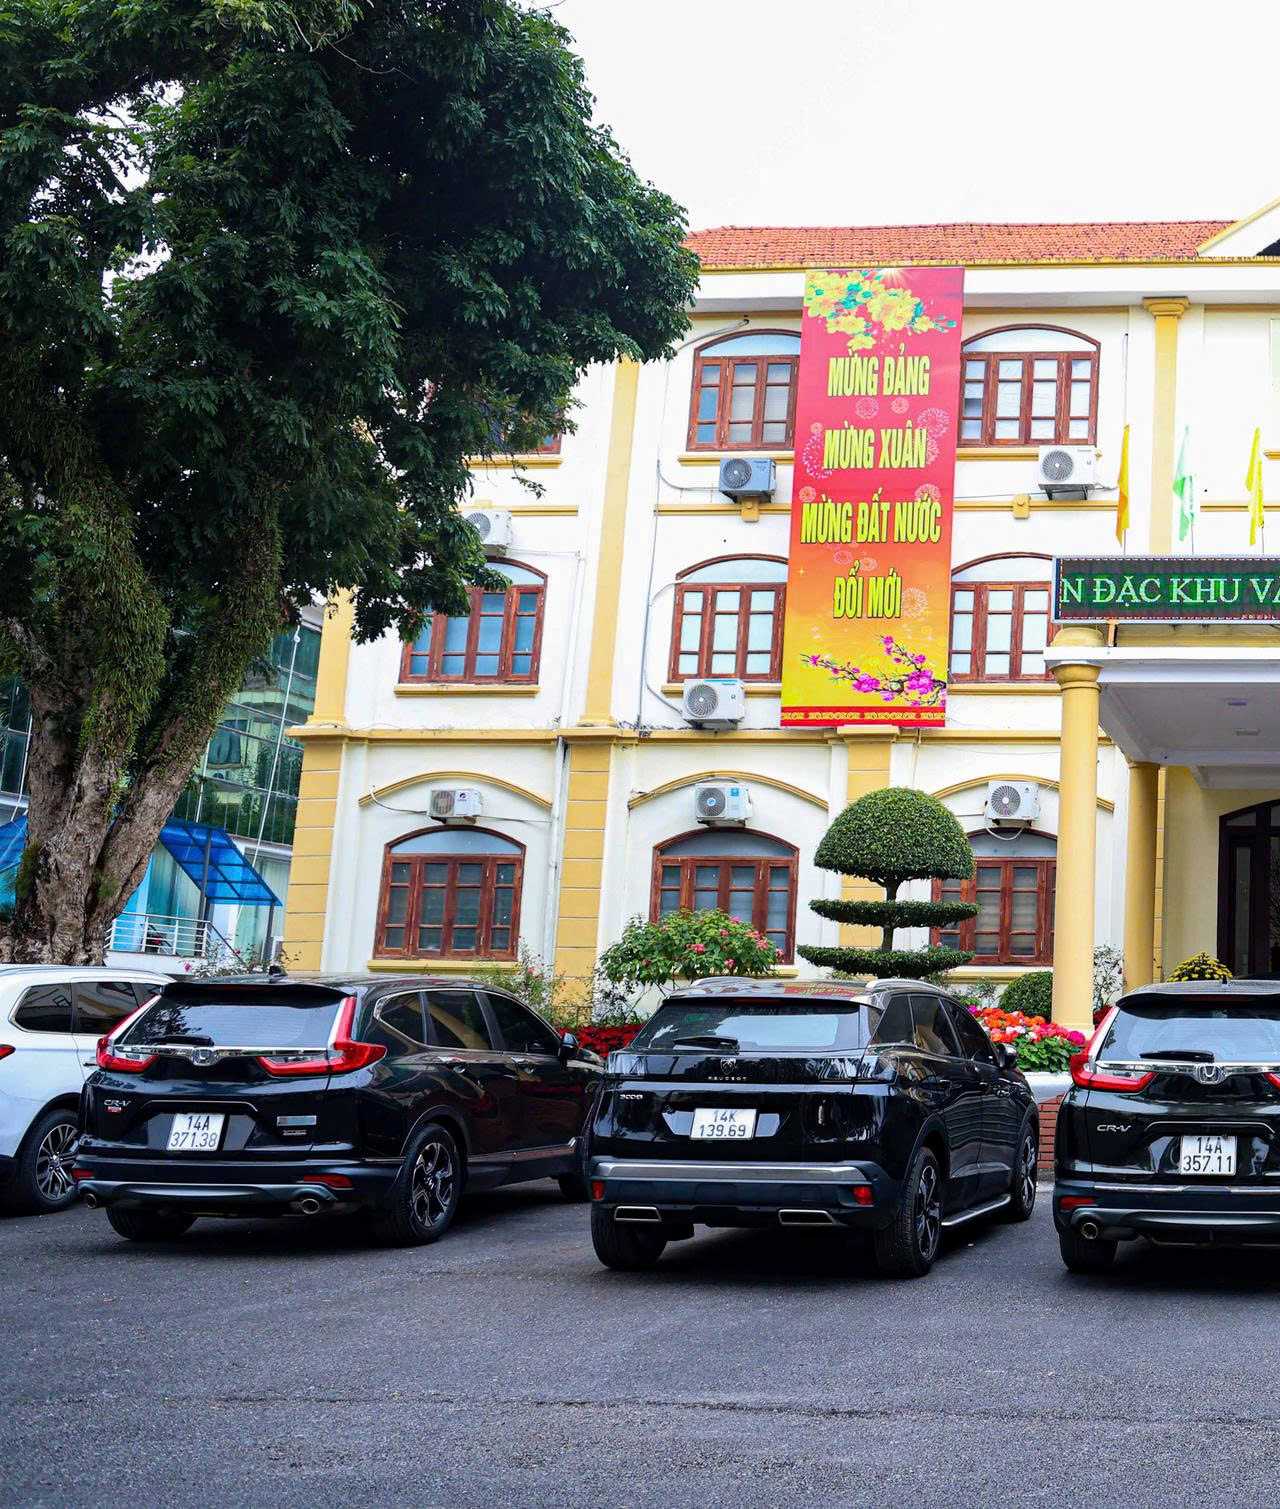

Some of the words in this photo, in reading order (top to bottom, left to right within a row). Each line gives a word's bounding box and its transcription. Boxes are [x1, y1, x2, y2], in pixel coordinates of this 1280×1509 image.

[827, 348, 879, 397] MỪNG
[882, 342, 931, 396] ĐẢNG
[823, 419, 876, 469] MỪNG
[878, 419, 928, 469] XUÂN
[800, 493, 853, 543] MỪNG
[856, 487, 890, 543] ĐẤT
[893, 492, 942, 543] NƯỚC
[833, 560, 863, 619] ĐỔI
[867, 567, 901, 619] MỚI
[1092, 575, 1162, 607] ĐẶC
[1169, 578, 1242, 603] KHU
[103, 1099, 131, 1107] CR-V
[187, 1115, 210, 1131] 14A
[713, 1109, 738, 1123] 14K
[699, 1124, 746, 1137] 139.69
[1096, 1124, 1131, 1133] CR-V
[170, 1131, 218, 1149] 371.38
[1197, 1137, 1222, 1154] 14A
[1183, 1155, 1232, 1173] 357.11
